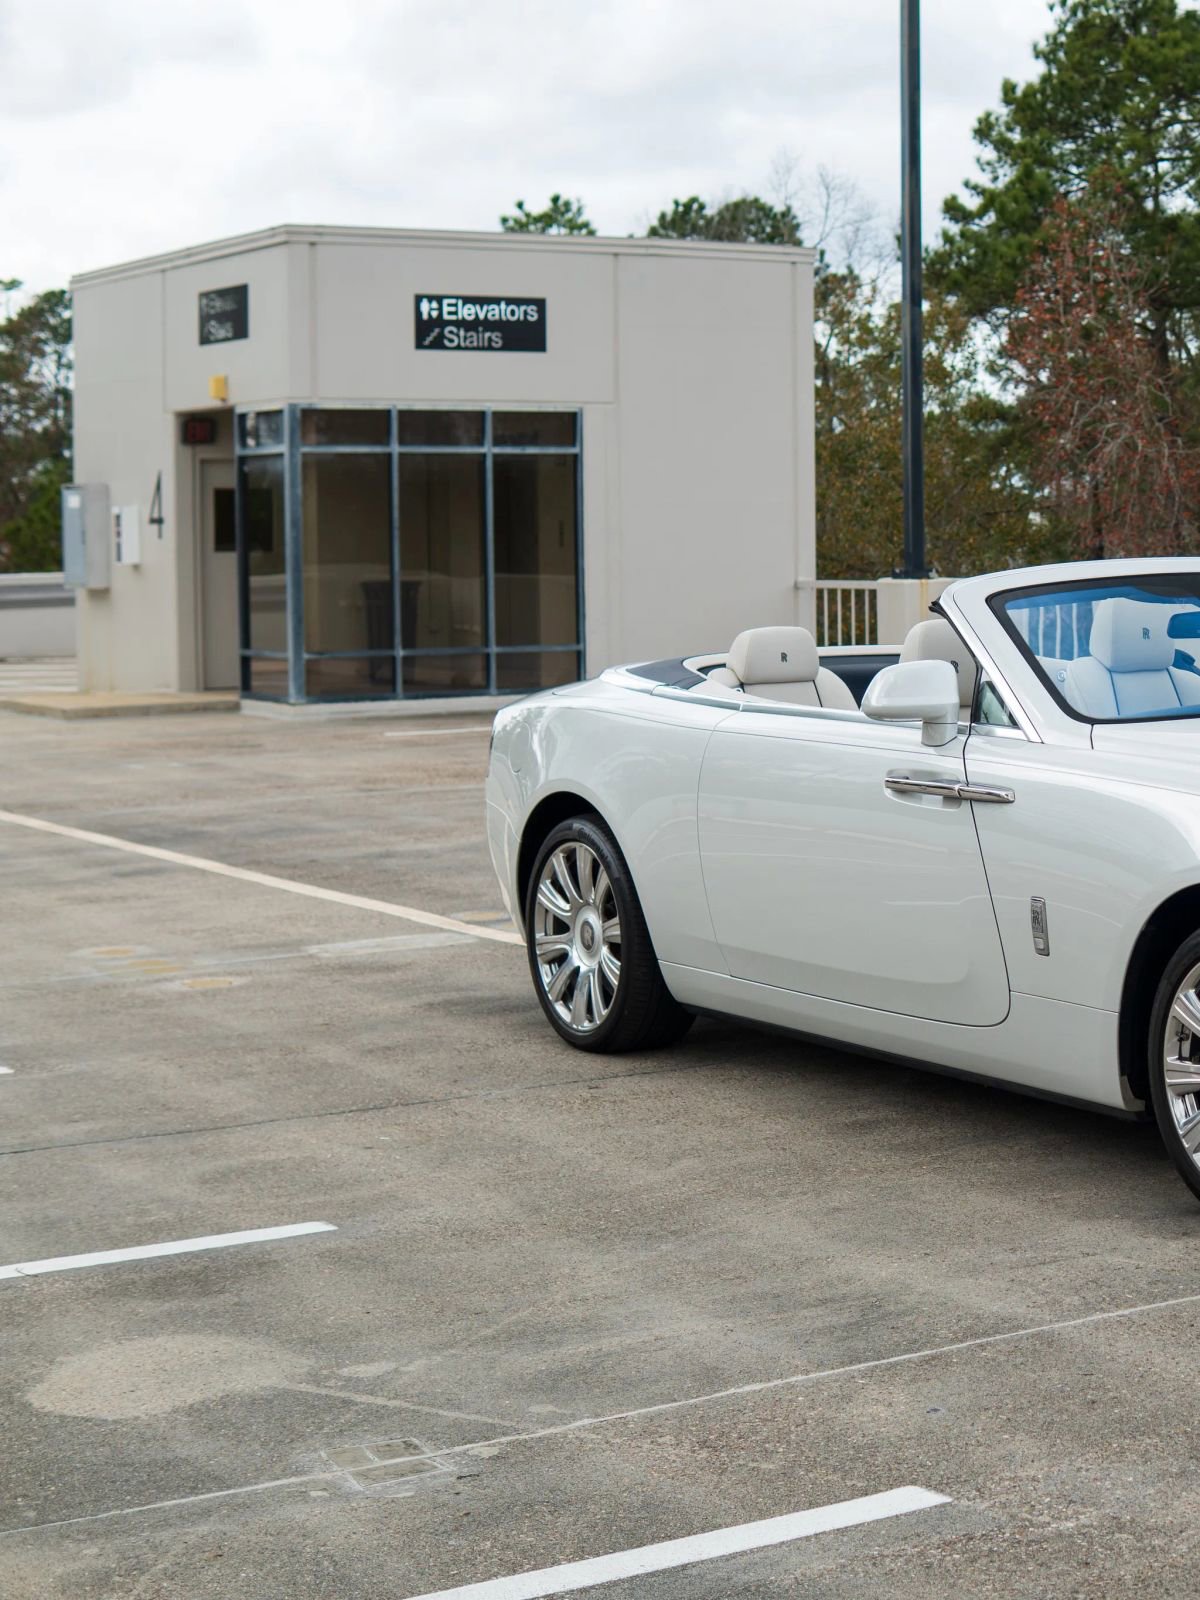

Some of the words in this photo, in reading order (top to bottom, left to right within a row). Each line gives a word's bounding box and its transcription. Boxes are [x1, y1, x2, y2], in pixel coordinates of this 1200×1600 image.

[442, 298, 539, 322] Elevators
[443, 325, 503, 348] Stairs
[149, 470, 163, 539] 4
